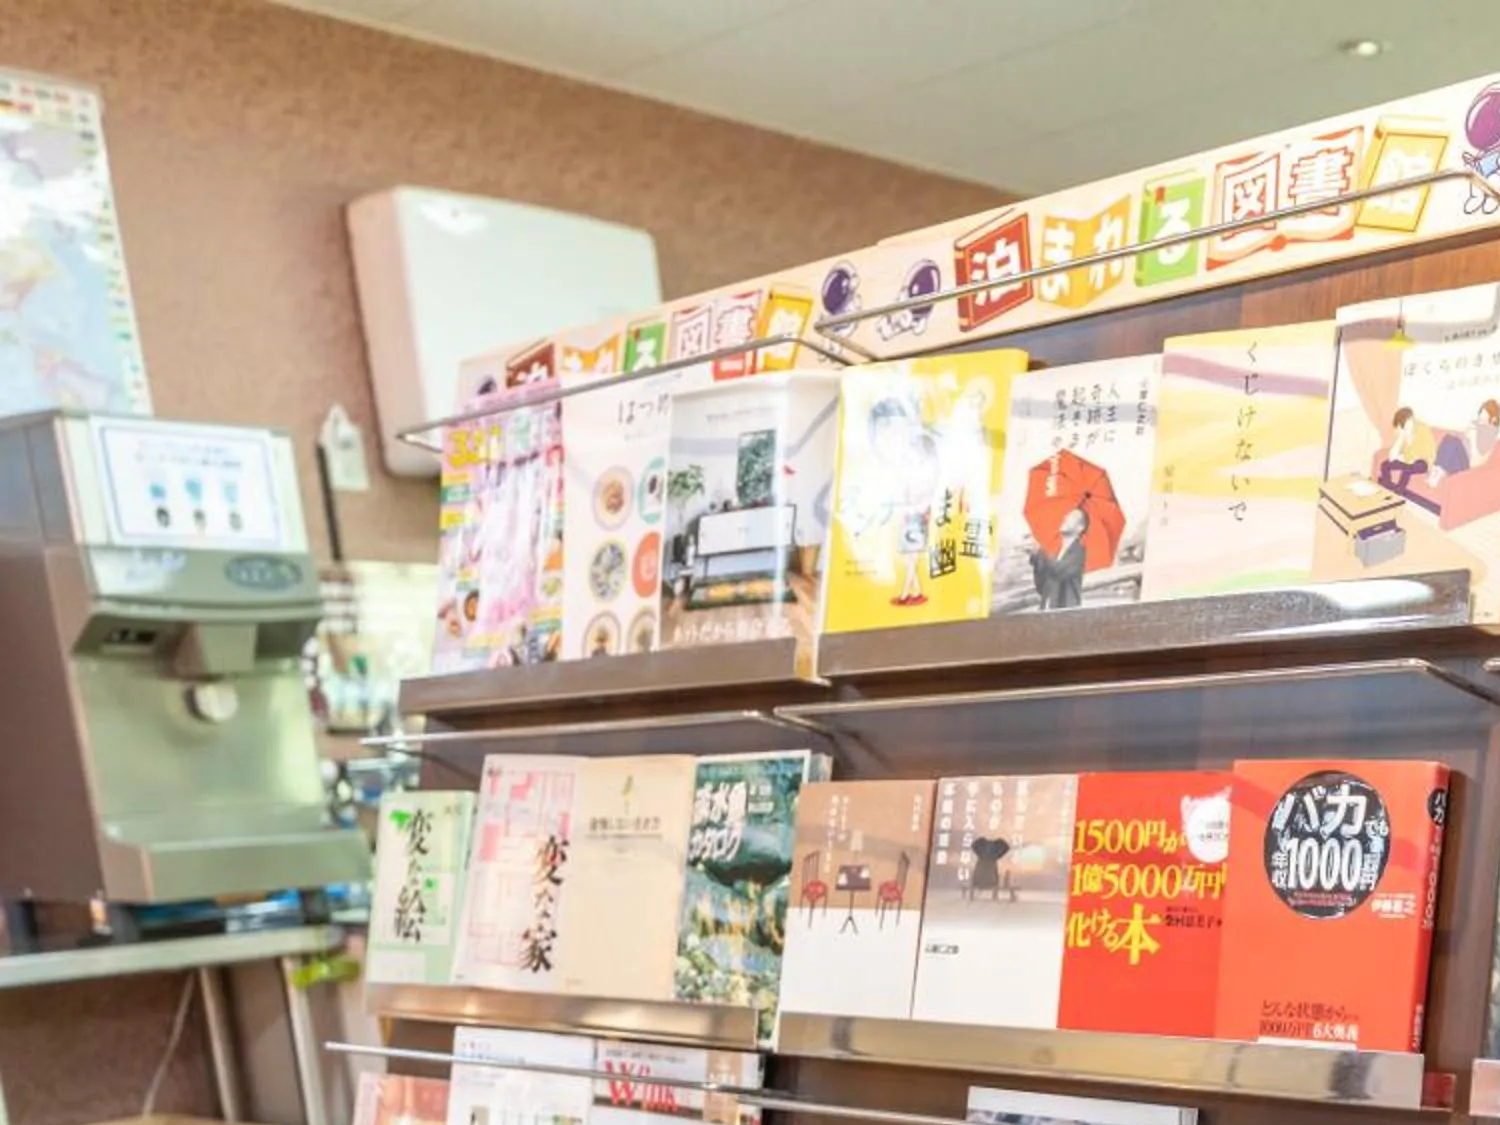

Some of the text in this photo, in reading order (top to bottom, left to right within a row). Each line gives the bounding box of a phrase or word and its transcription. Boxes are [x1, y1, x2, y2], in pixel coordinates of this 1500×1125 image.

[1228, 340, 1258, 522] くじけないで
[1067, 902, 1161, 966] 化ける本
